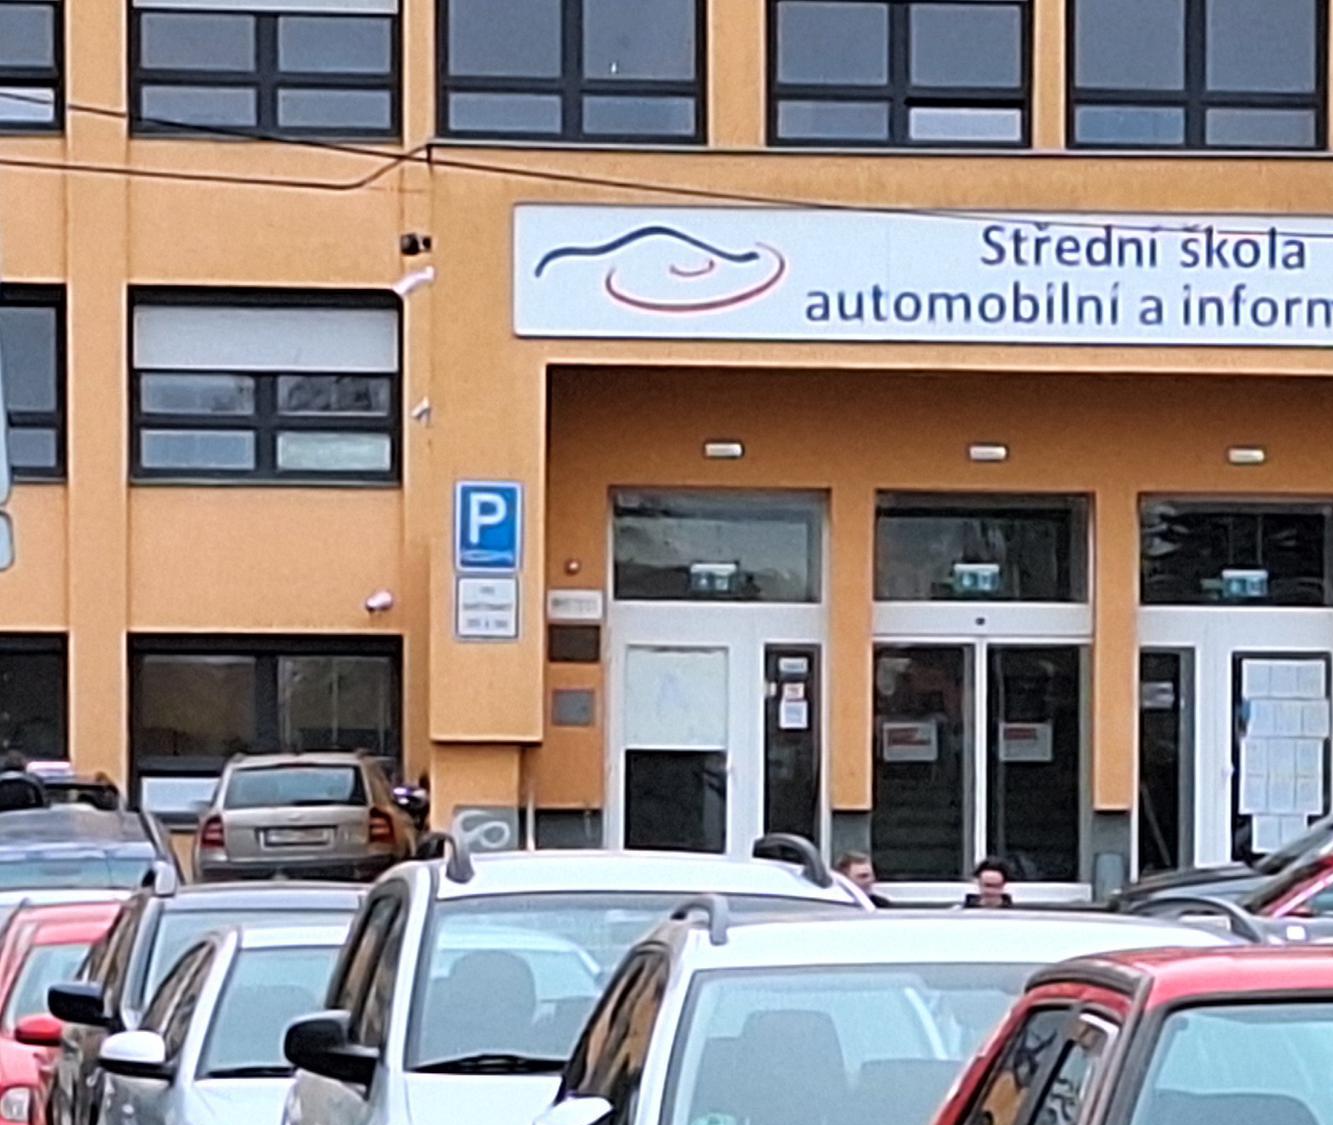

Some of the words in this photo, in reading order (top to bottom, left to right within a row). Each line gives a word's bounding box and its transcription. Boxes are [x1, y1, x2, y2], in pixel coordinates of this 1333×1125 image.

[980, 221, 1161, 268] Střední
[1179, 224, 1307, 270] škola
[805, 281, 1120, 325] automobilní
[1139, 294, 1163, 326] a
[469, 492, 508, 545] P
